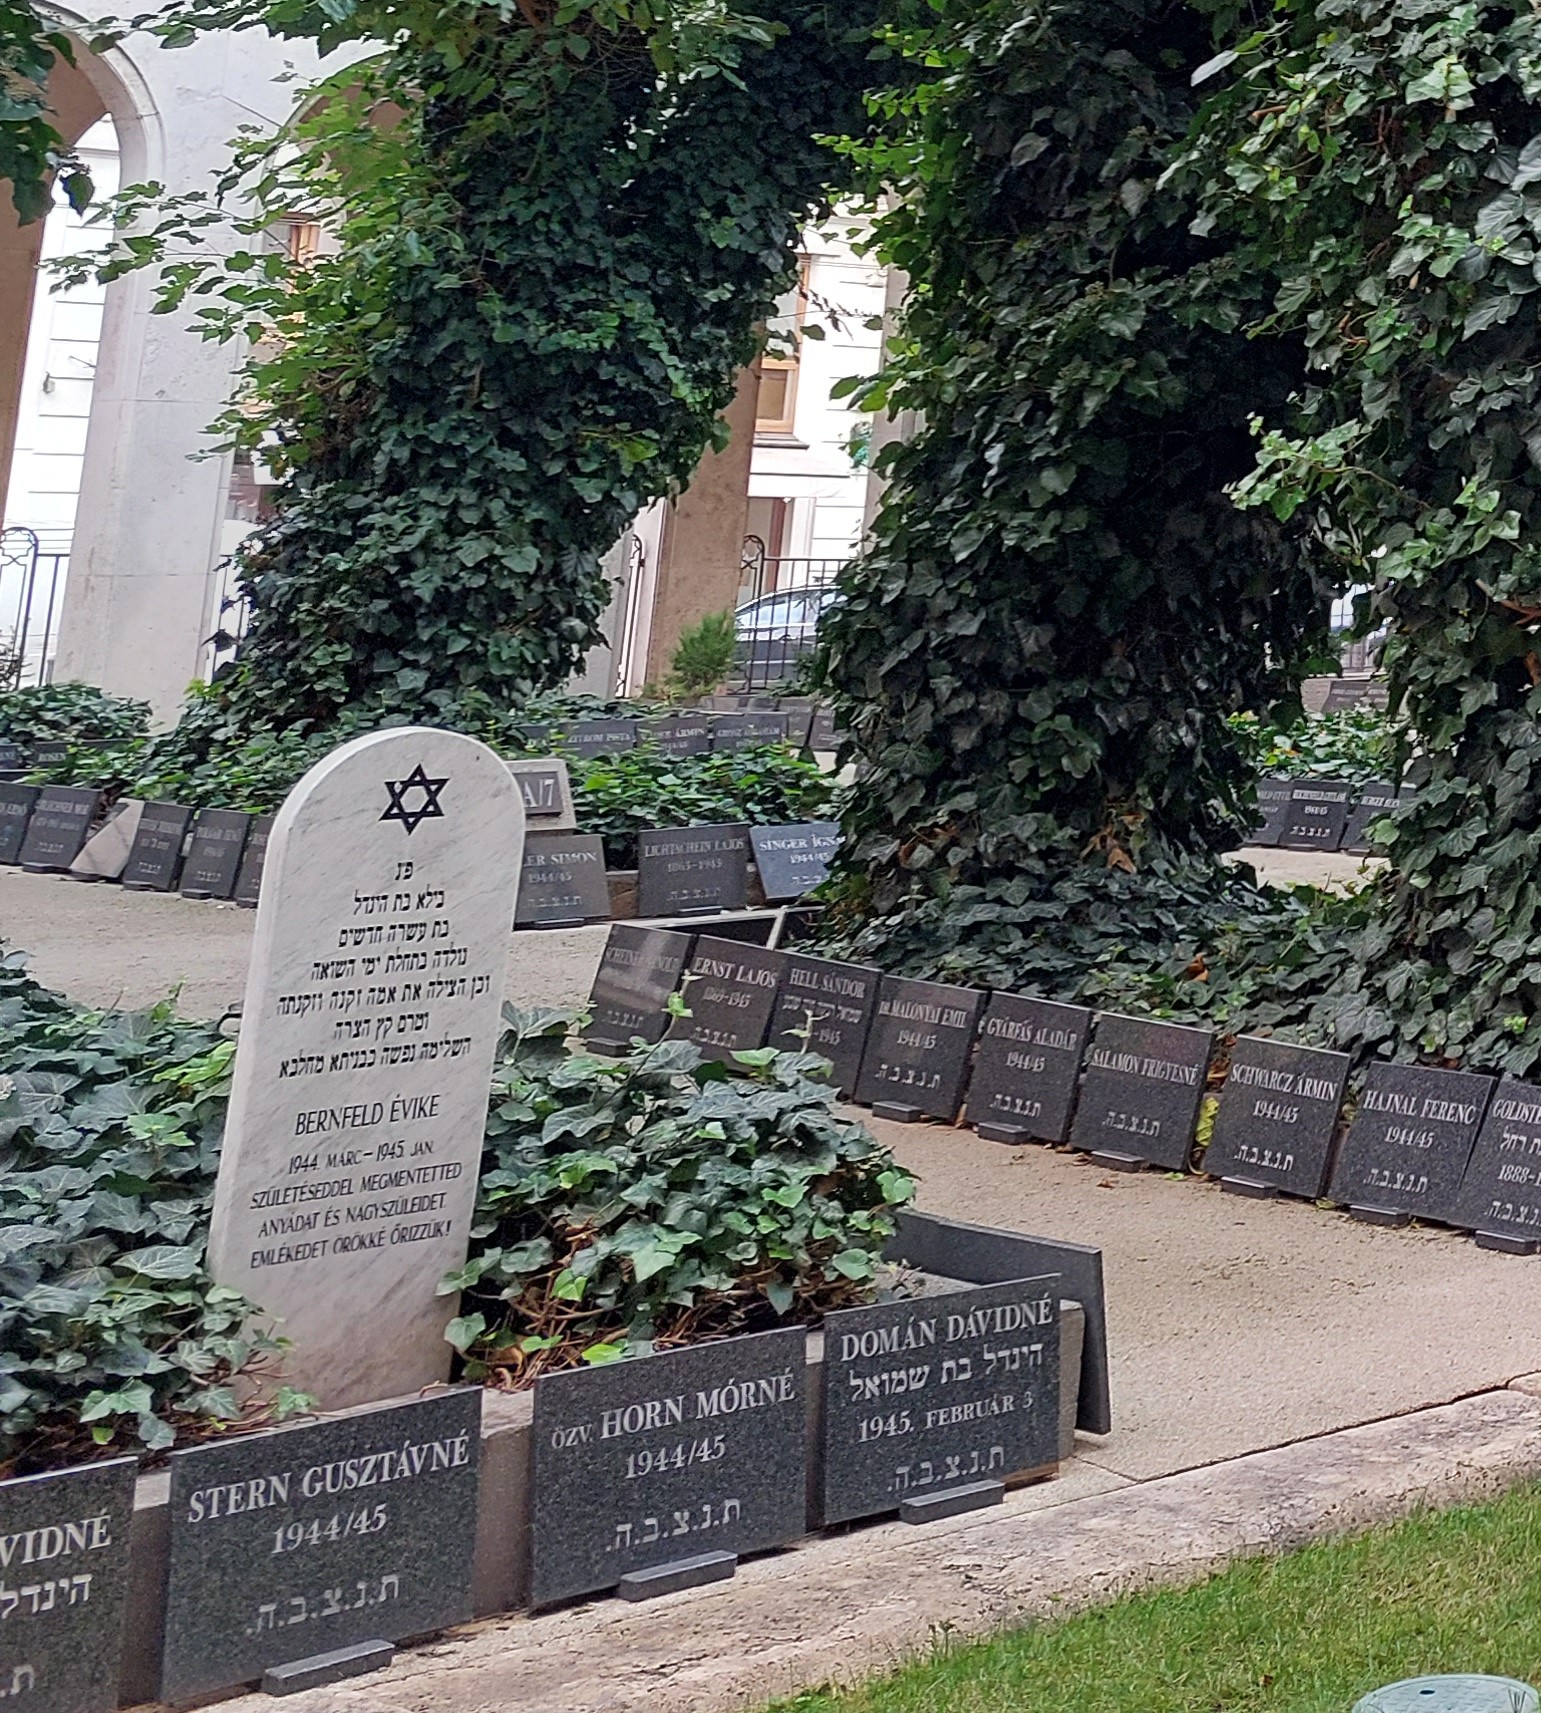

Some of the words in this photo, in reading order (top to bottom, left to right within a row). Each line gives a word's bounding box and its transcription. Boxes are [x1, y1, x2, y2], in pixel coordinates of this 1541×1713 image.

[758, 838, 806, 852] SINGER
[393, 893, 411, 912] בת
[339, 926, 383, 947] חדשים
[387, 922, 427, 942] עשרה
[431, 920, 449, 938] בת
[362, 957, 381, 975] ימי
[432, 942, 467, 968] נולדה
[311, 959, 356, 981] השואה
[693, 957, 736, 978] ERNST
[736, 964, 779, 989] LAJOS
[789, 968, 822, 989] HELL
[822, 970, 866, 999] SÁNDOR
[366, 986, 396, 1005] אמה
[402, 983, 422, 1002] את
[427, 973, 466, 998] הצילה
[941, 1009, 967, 1029] EMIL
[987, 1016, 1031, 1043] GYÁRFÁS
[1033, 1028, 1078, 1051] ALADÁR
[896, 1030, 936, 1049] 1944/45
[1006, 1052, 1045, 1072] 1944/45
[1092, 1050, 1140, 1074] SALAMON
[1142, 1058, 1198, 1087] FRIGYESNÉ
[1230, 1063, 1293, 1092] SCHWARCZ
[1296, 1073, 1338, 1101] ÁRMIN
[295, 1102, 383, 1135] BERNFELD
[389, 1094, 441, 1122] ÉVIKE
[1252, 1100, 1299, 1124] 1944/45
[1362, 1090, 1417, 1115] HAJNAL
[1421, 1099, 1477, 1124] FERENC
[1385, 1126, 1434, 1148] 1944/45
[1499, 1126, 1526, 1152] רחל
[250, 1177, 354, 1209] SZÜLETÉSEDDEL
[360, 1162, 463, 1192] MEGMENTETTED
[258, 1211, 321, 1238] ANYÁDAT
[324, 1206, 341, 1227] ÉS
[250, 1239, 328, 1269] EMLÉKEDET
[333, 1226, 387, 1254] ÖRÖKKÉ
[390, 1219, 452, 1246] ŐRIZZÜK!
[840, 1319, 936, 1363] DOMÁN
[946, 1297, 1054, 1344] DÁVIDNÉ
[940, 1357, 972, 1384] בת
[983, 1342, 1043, 1374] הינדל
[849, 1363, 930, 1402] שמואל
[600, 1396, 686, 1440] HORN
[696, 1373, 796, 1421] MÓRNÉ
[859, 1410, 915, 1444] 1945.
[924, 1394, 1015, 1430] FEBRUÁR
[1022, 1391, 1034, 1410] 3
[625, 1434, 726, 1481] 1944/45
[187, 1472, 293, 1525] STERN
[302, 1434, 470, 1496] GUSZTÁVNÉ
[271, 1503, 388, 1555] 1944/45
